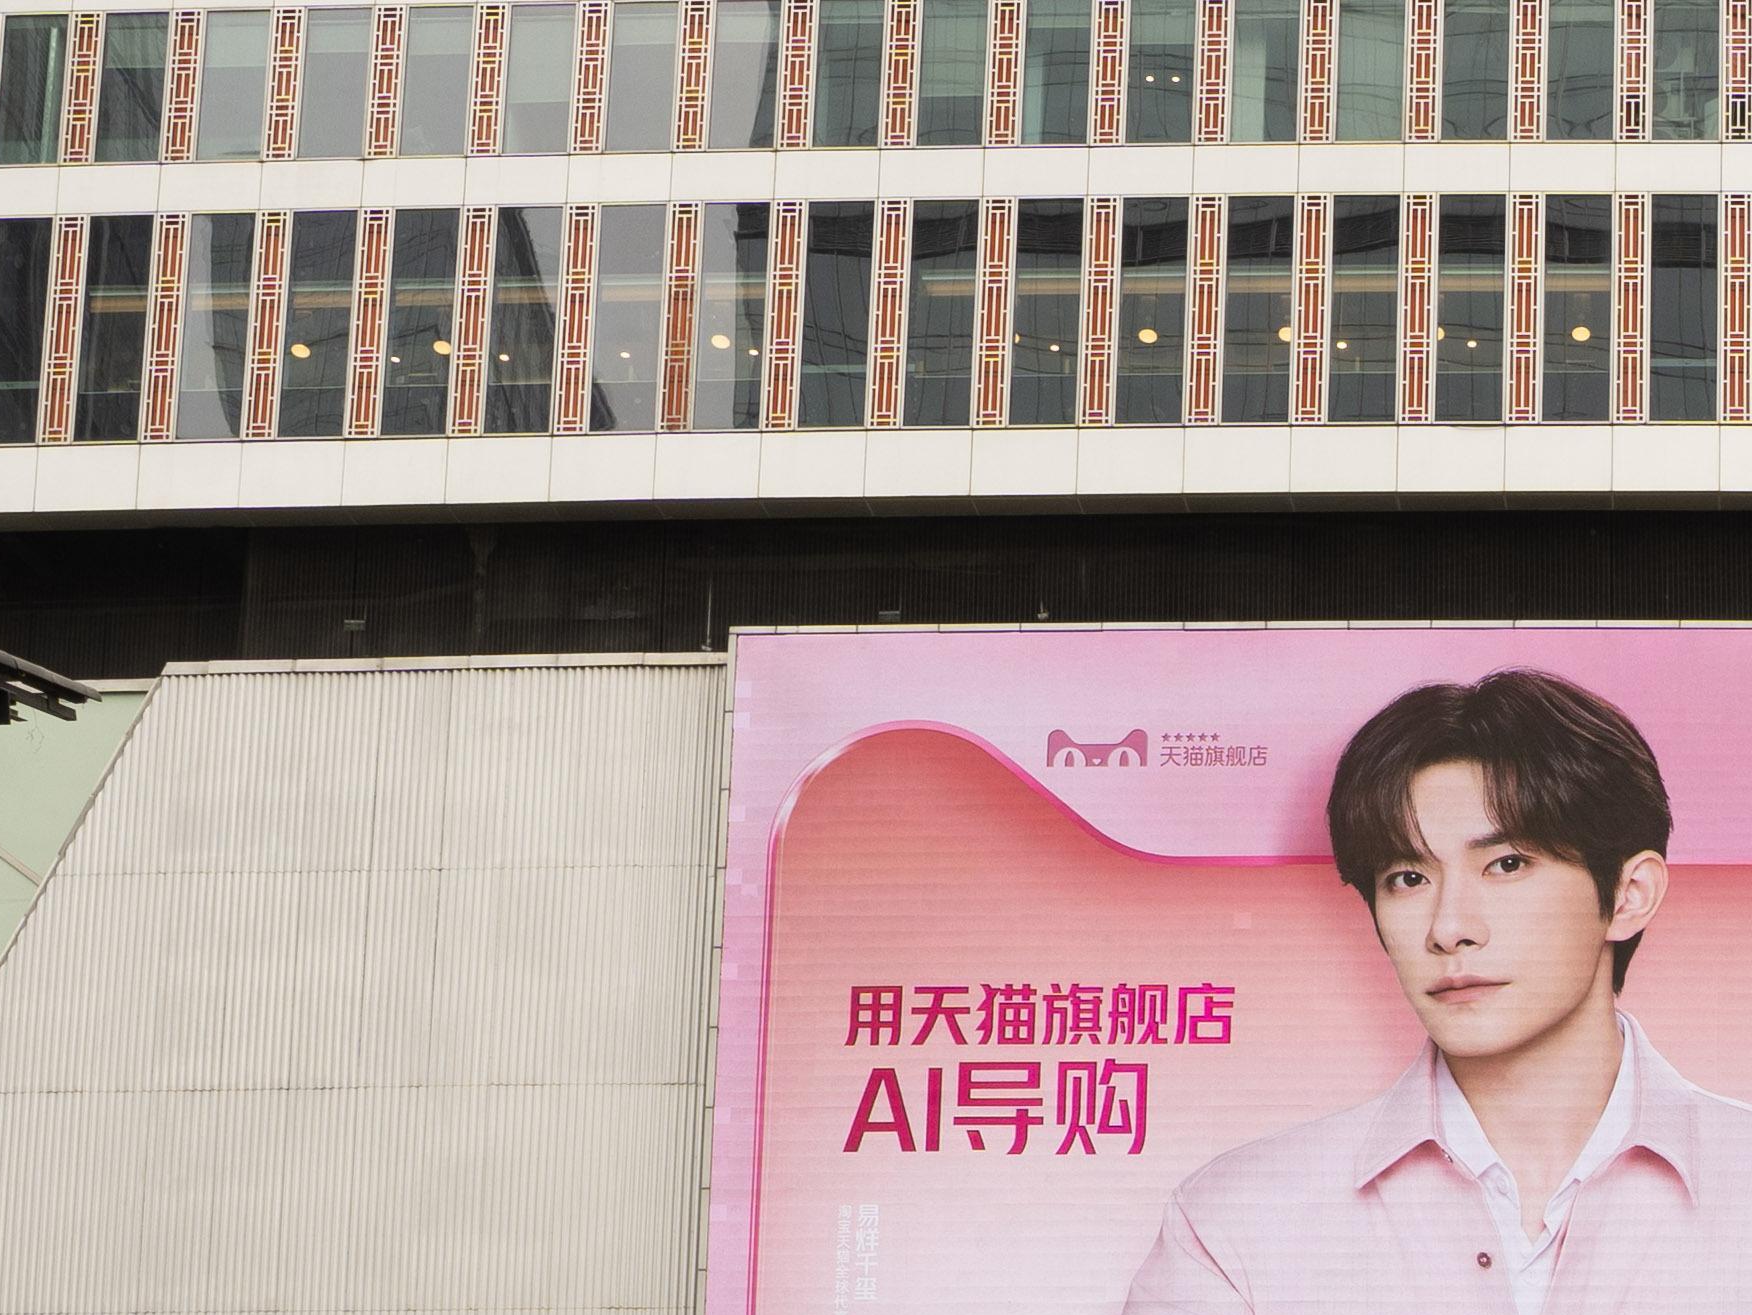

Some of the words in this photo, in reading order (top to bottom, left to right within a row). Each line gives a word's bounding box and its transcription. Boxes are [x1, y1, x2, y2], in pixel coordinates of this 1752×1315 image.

[1160, 745, 1267, 768] 天猫旗舰店
[844, 983, 1236, 1046] 用天猫旗舰店
[842, 1058, 1150, 1156] AI导购
[854, 1204, 879, 1300] 易烊千玺
